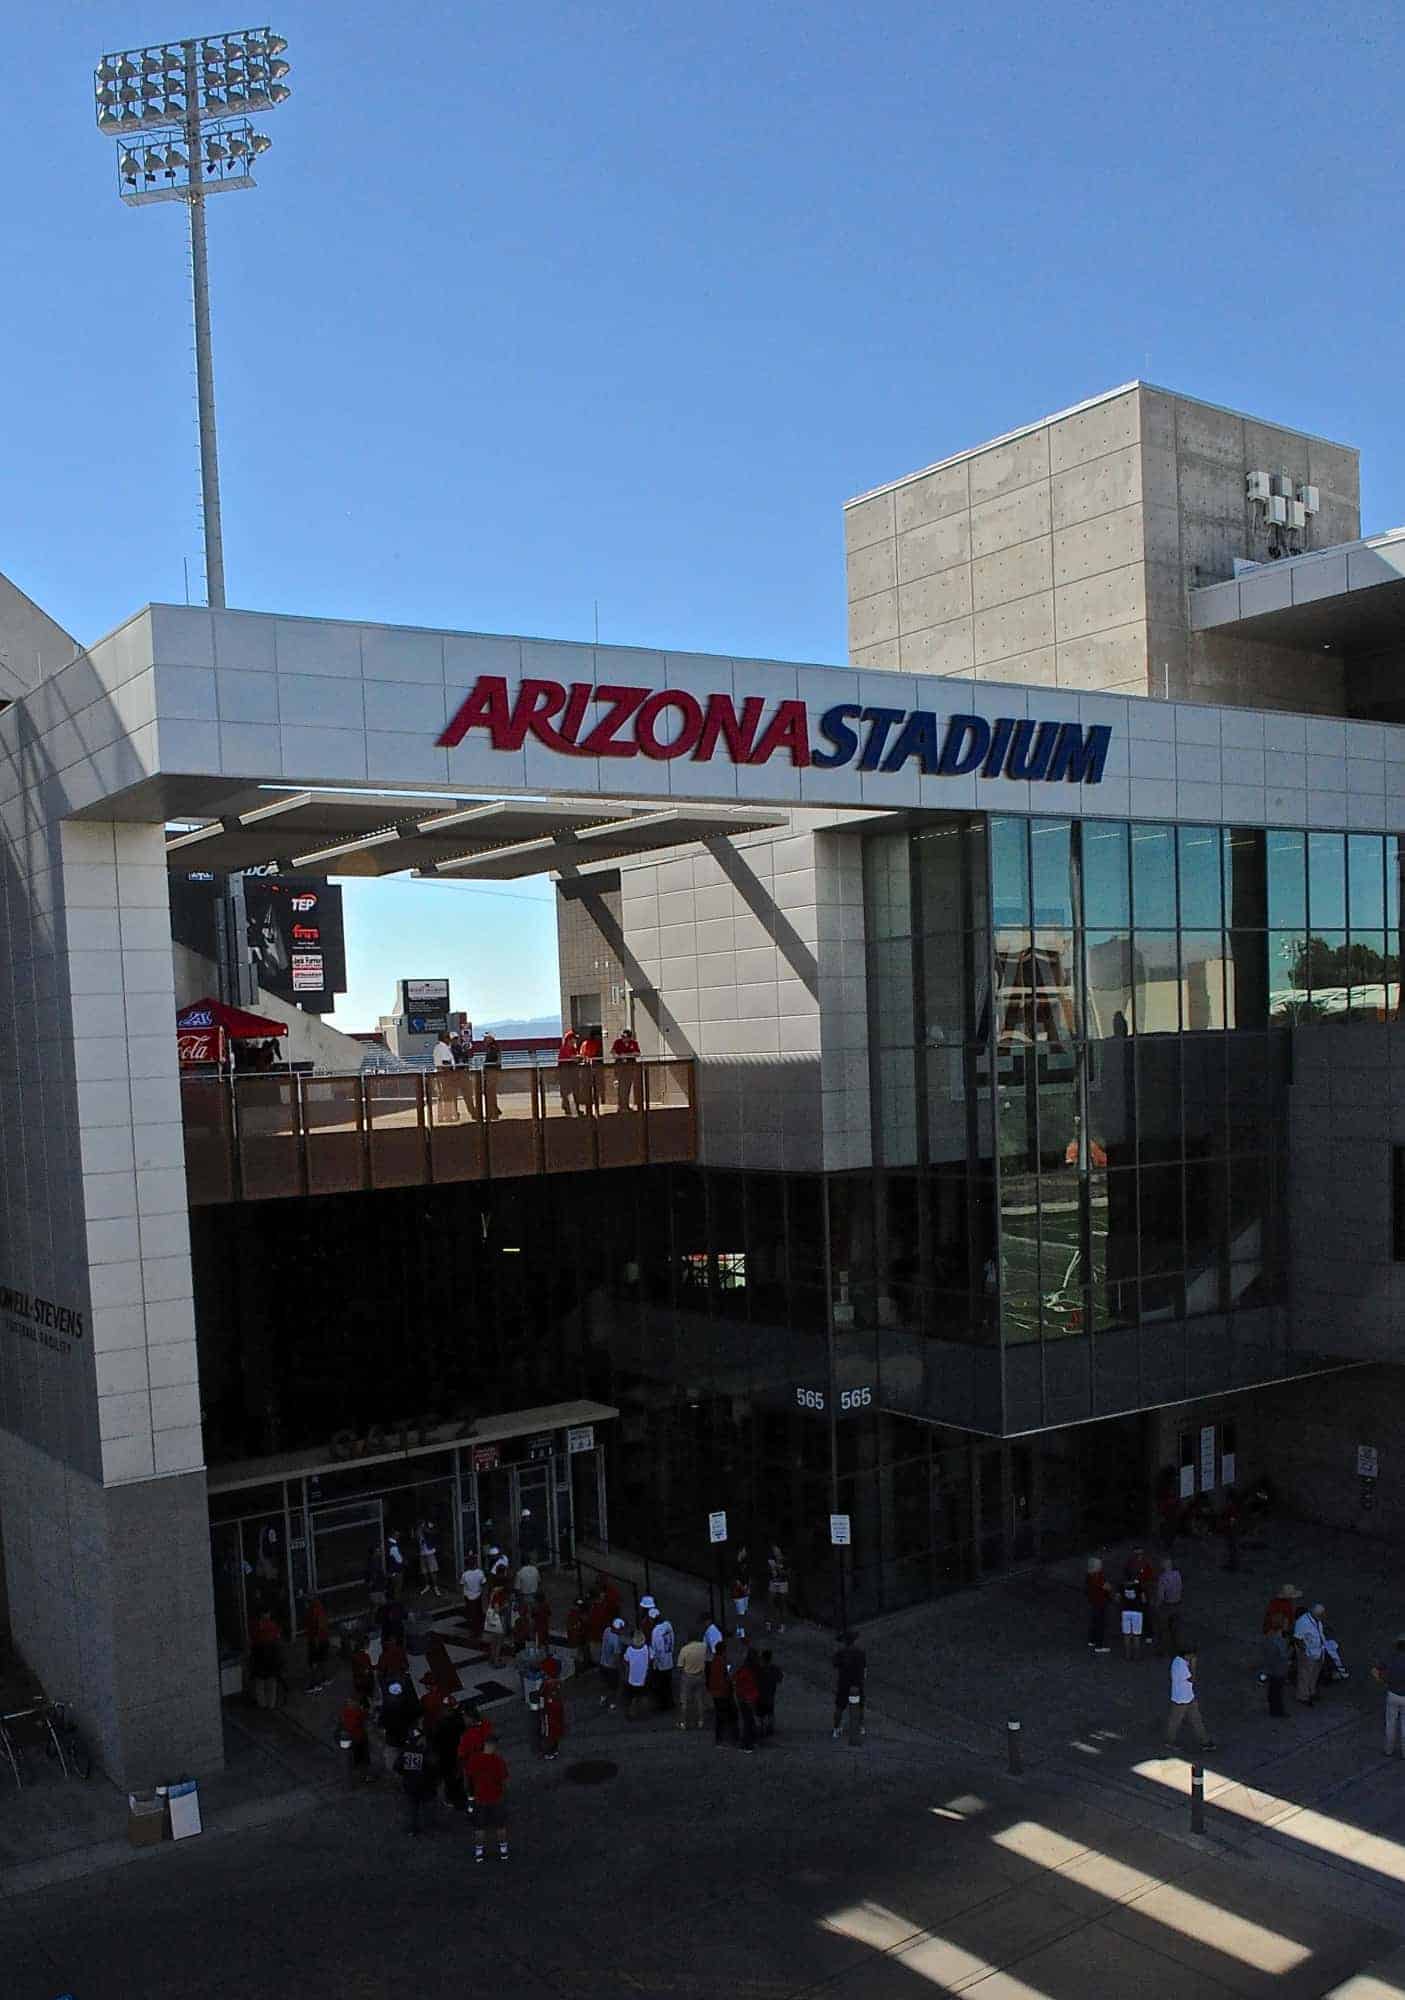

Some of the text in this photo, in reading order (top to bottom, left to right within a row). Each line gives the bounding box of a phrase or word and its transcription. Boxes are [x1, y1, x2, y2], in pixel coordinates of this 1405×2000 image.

[434, 675, 1112, 784] ARIZONA STADIUM
[291, 897, 315, 912] TEP
[796, 1387, 825, 1410] 565
[841, 1387, 872, 1410] 565
